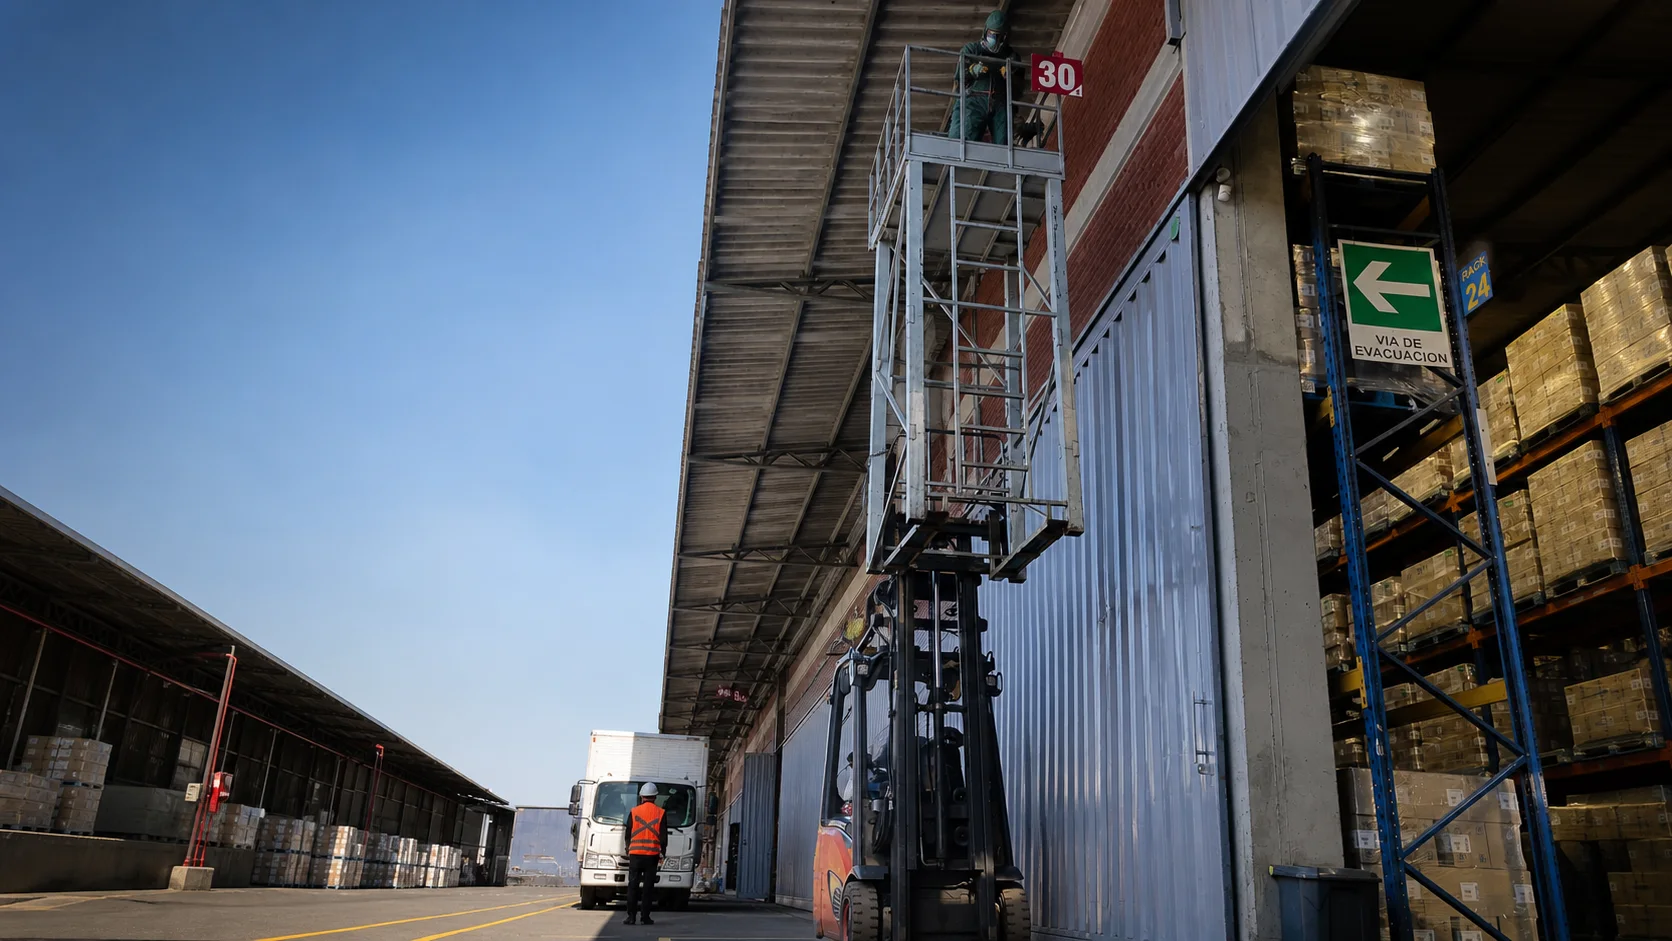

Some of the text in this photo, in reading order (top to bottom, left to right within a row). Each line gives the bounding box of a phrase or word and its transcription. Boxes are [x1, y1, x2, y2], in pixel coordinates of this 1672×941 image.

[1039, 60, 1075, 90] 30
[1462, 256, 1487, 282] RACK
[1466, 272, 1491, 311] 24
[1355, 346, 1448, 363] EVACUACION
[1375, 335, 1422, 349] VIA DE
